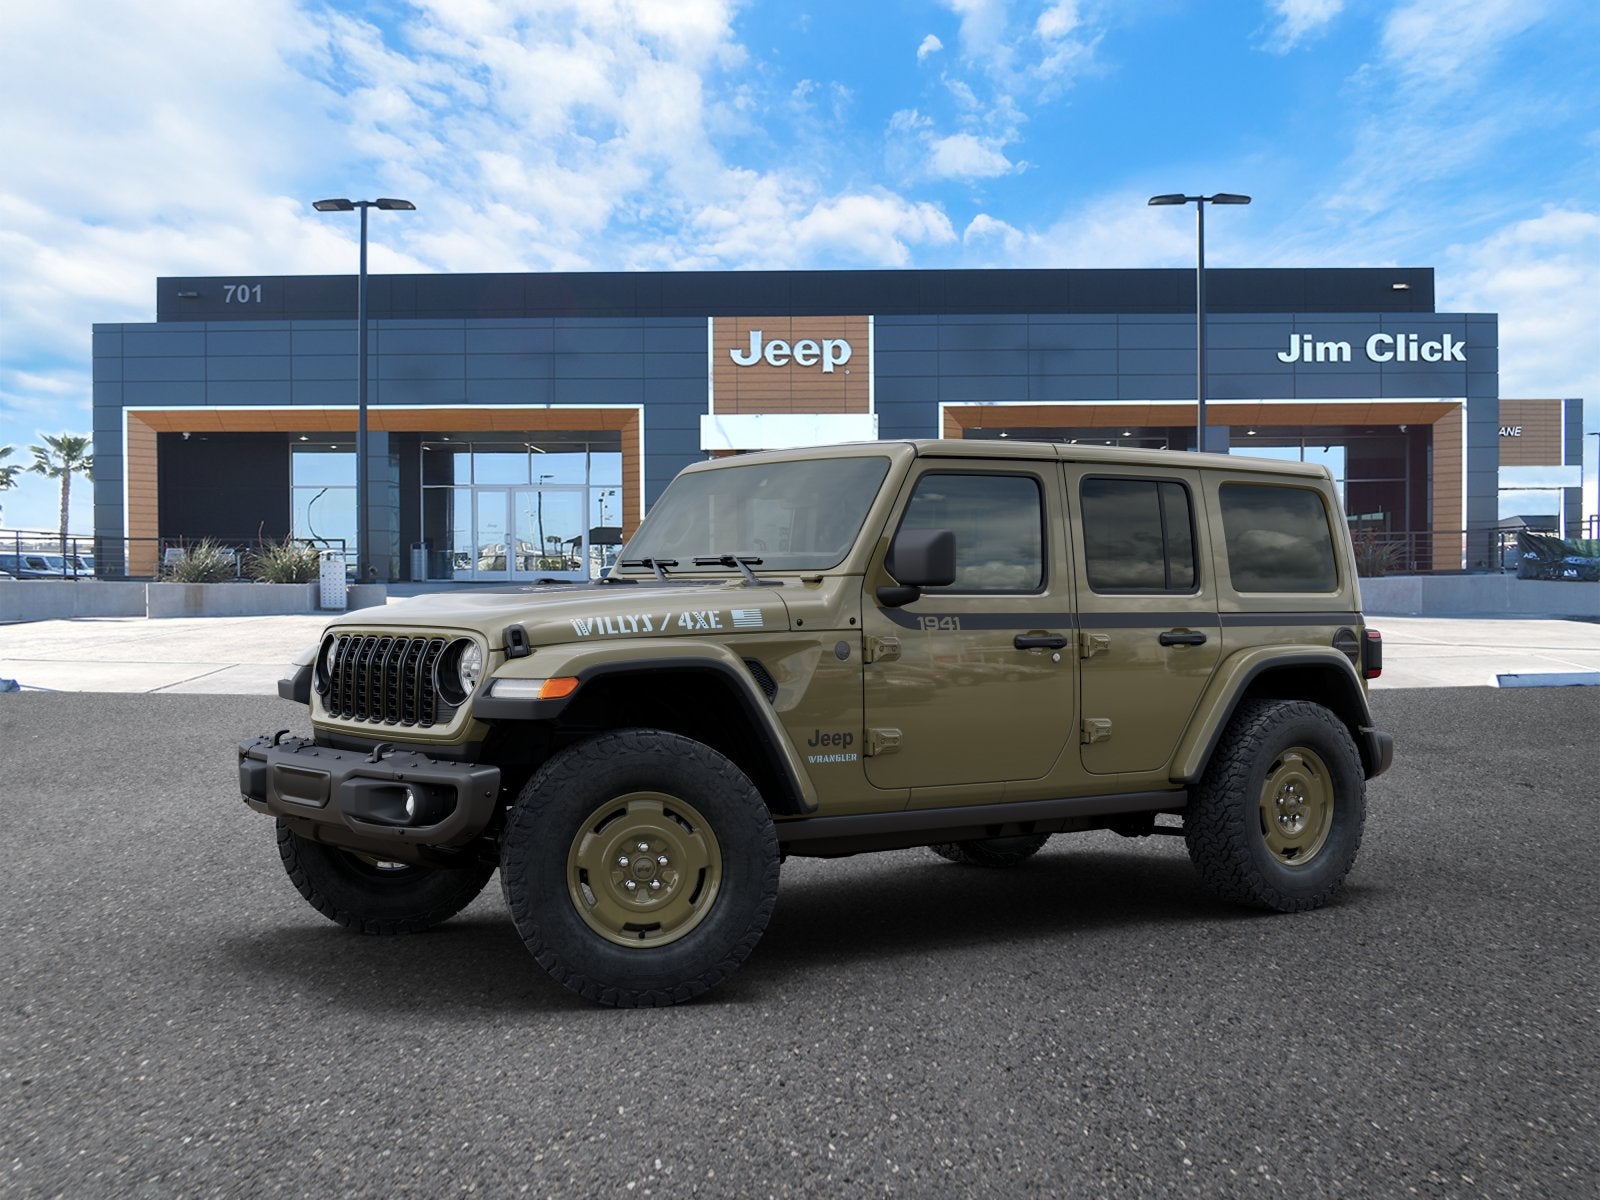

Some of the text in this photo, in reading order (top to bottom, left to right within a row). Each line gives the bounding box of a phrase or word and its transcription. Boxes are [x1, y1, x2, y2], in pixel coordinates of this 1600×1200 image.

[223, 284, 262, 303] 701
[729, 329, 852, 373] Jeep
[1277, 333, 1467, 363] Jim Click
[570, 614, 652, 637] WILLYS
[916, 616, 961, 631] 1941
[807, 729, 854, 749] Jeep
[807, 753, 857, 763] WRANGLER
